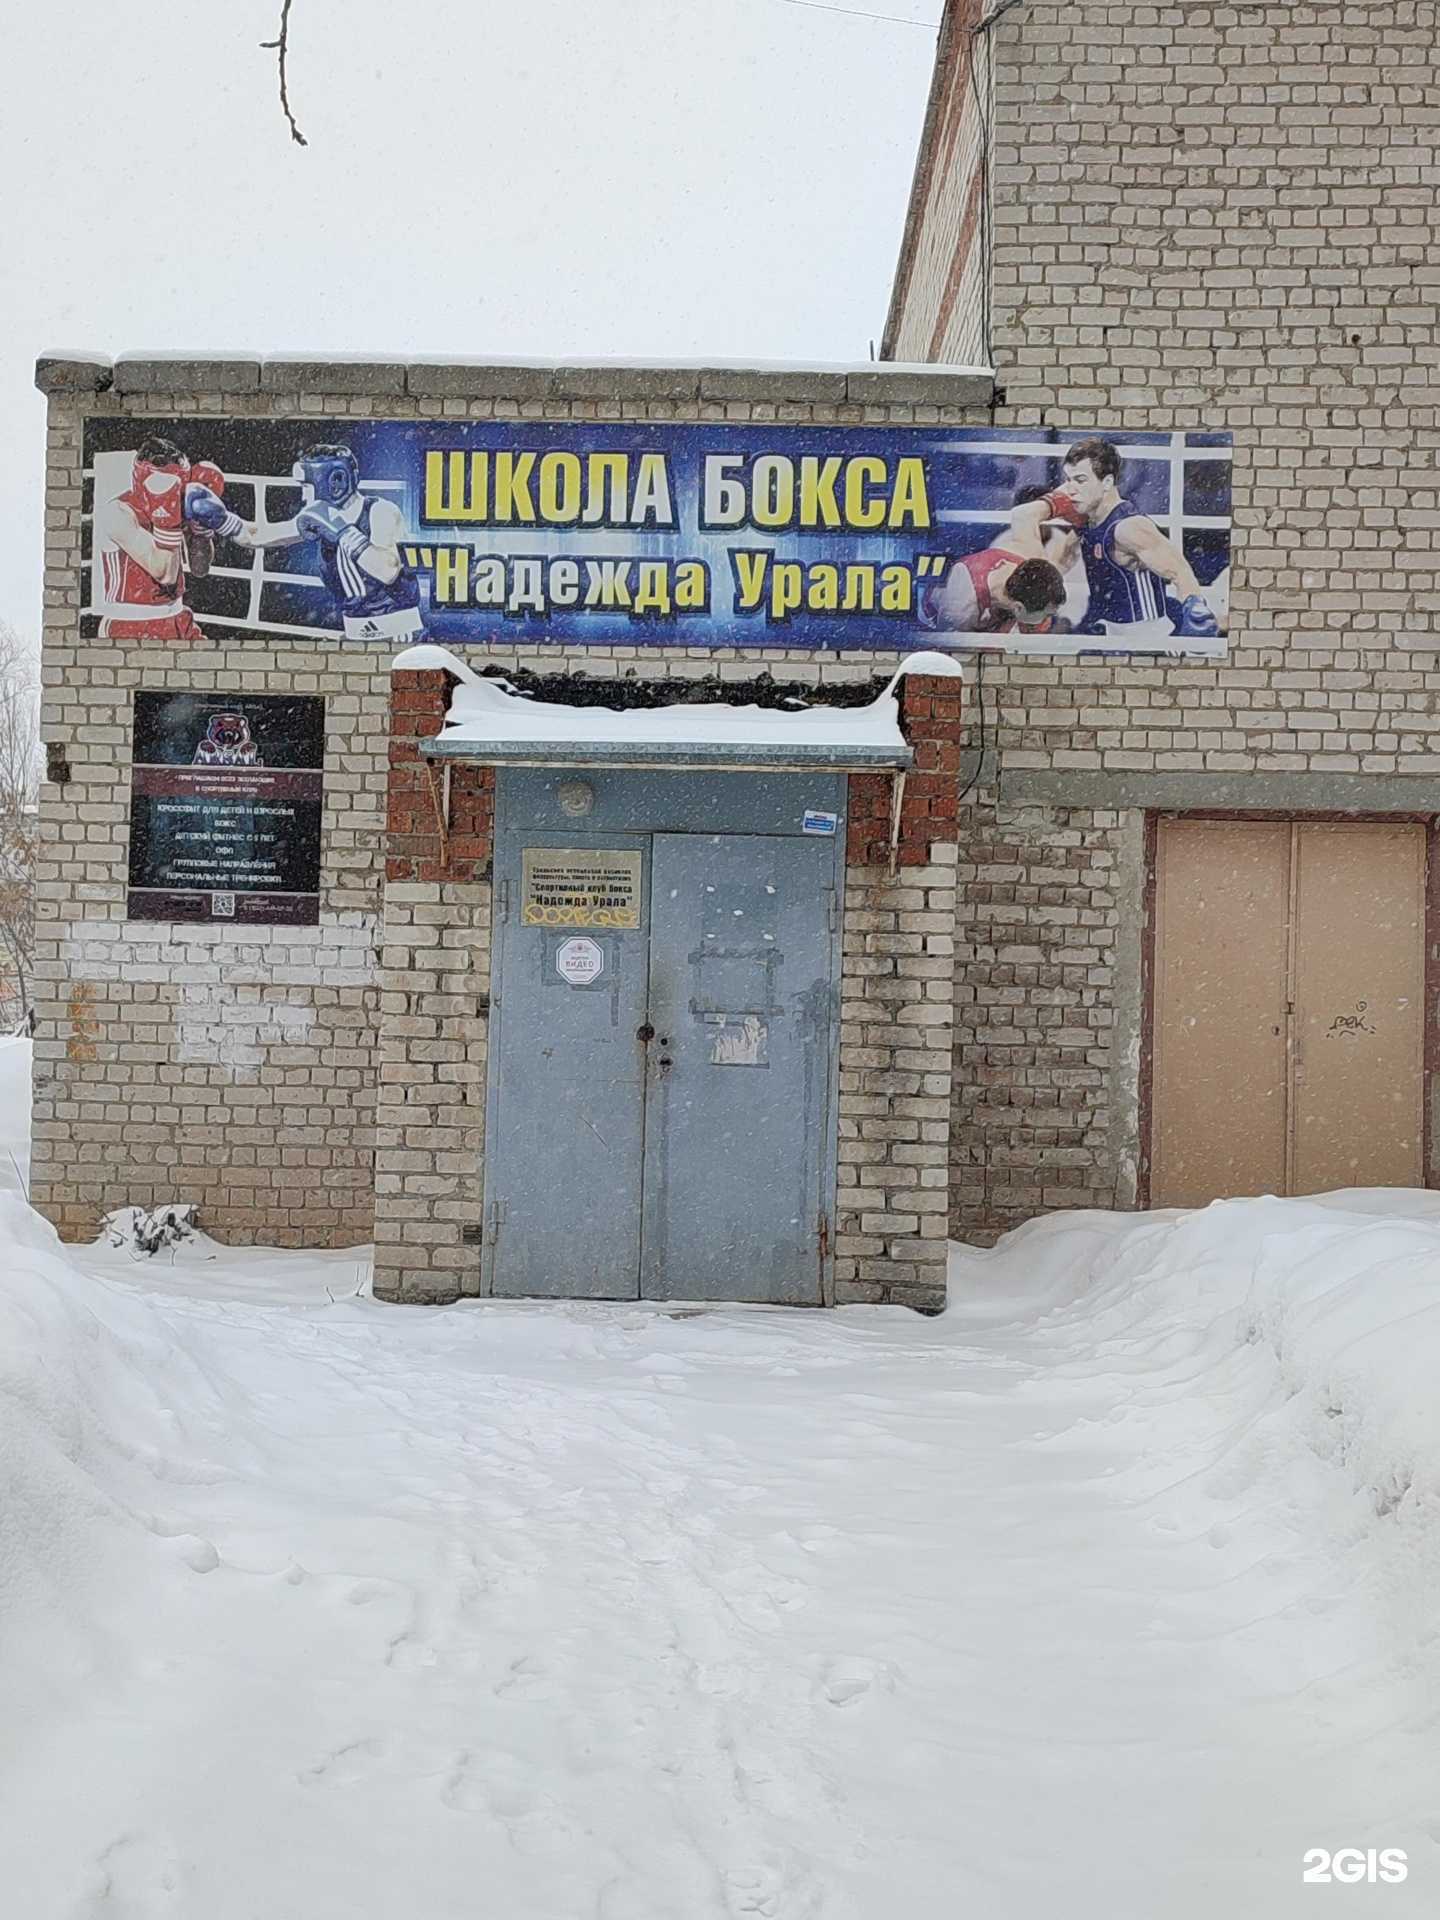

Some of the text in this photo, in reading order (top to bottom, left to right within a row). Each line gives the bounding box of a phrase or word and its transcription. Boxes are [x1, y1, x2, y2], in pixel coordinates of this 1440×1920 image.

[424, 450, 931, 528] ШКОЛА БОКСА
[404, 547, 947, 618] "Надежда Урала"
[202, 805, 219, 815] ДЛЯ
[220, 805, 245, 815] ДЕТЕЙ
[246, 807, 253, 815] И
[219, 859, 276, 870] НАПРАВЛЕНИЯ
[166, 871, 229, 882] ПЕРСОНАЛЬНЫЕ
[565, 960, 594, 969] ВИДЕО
